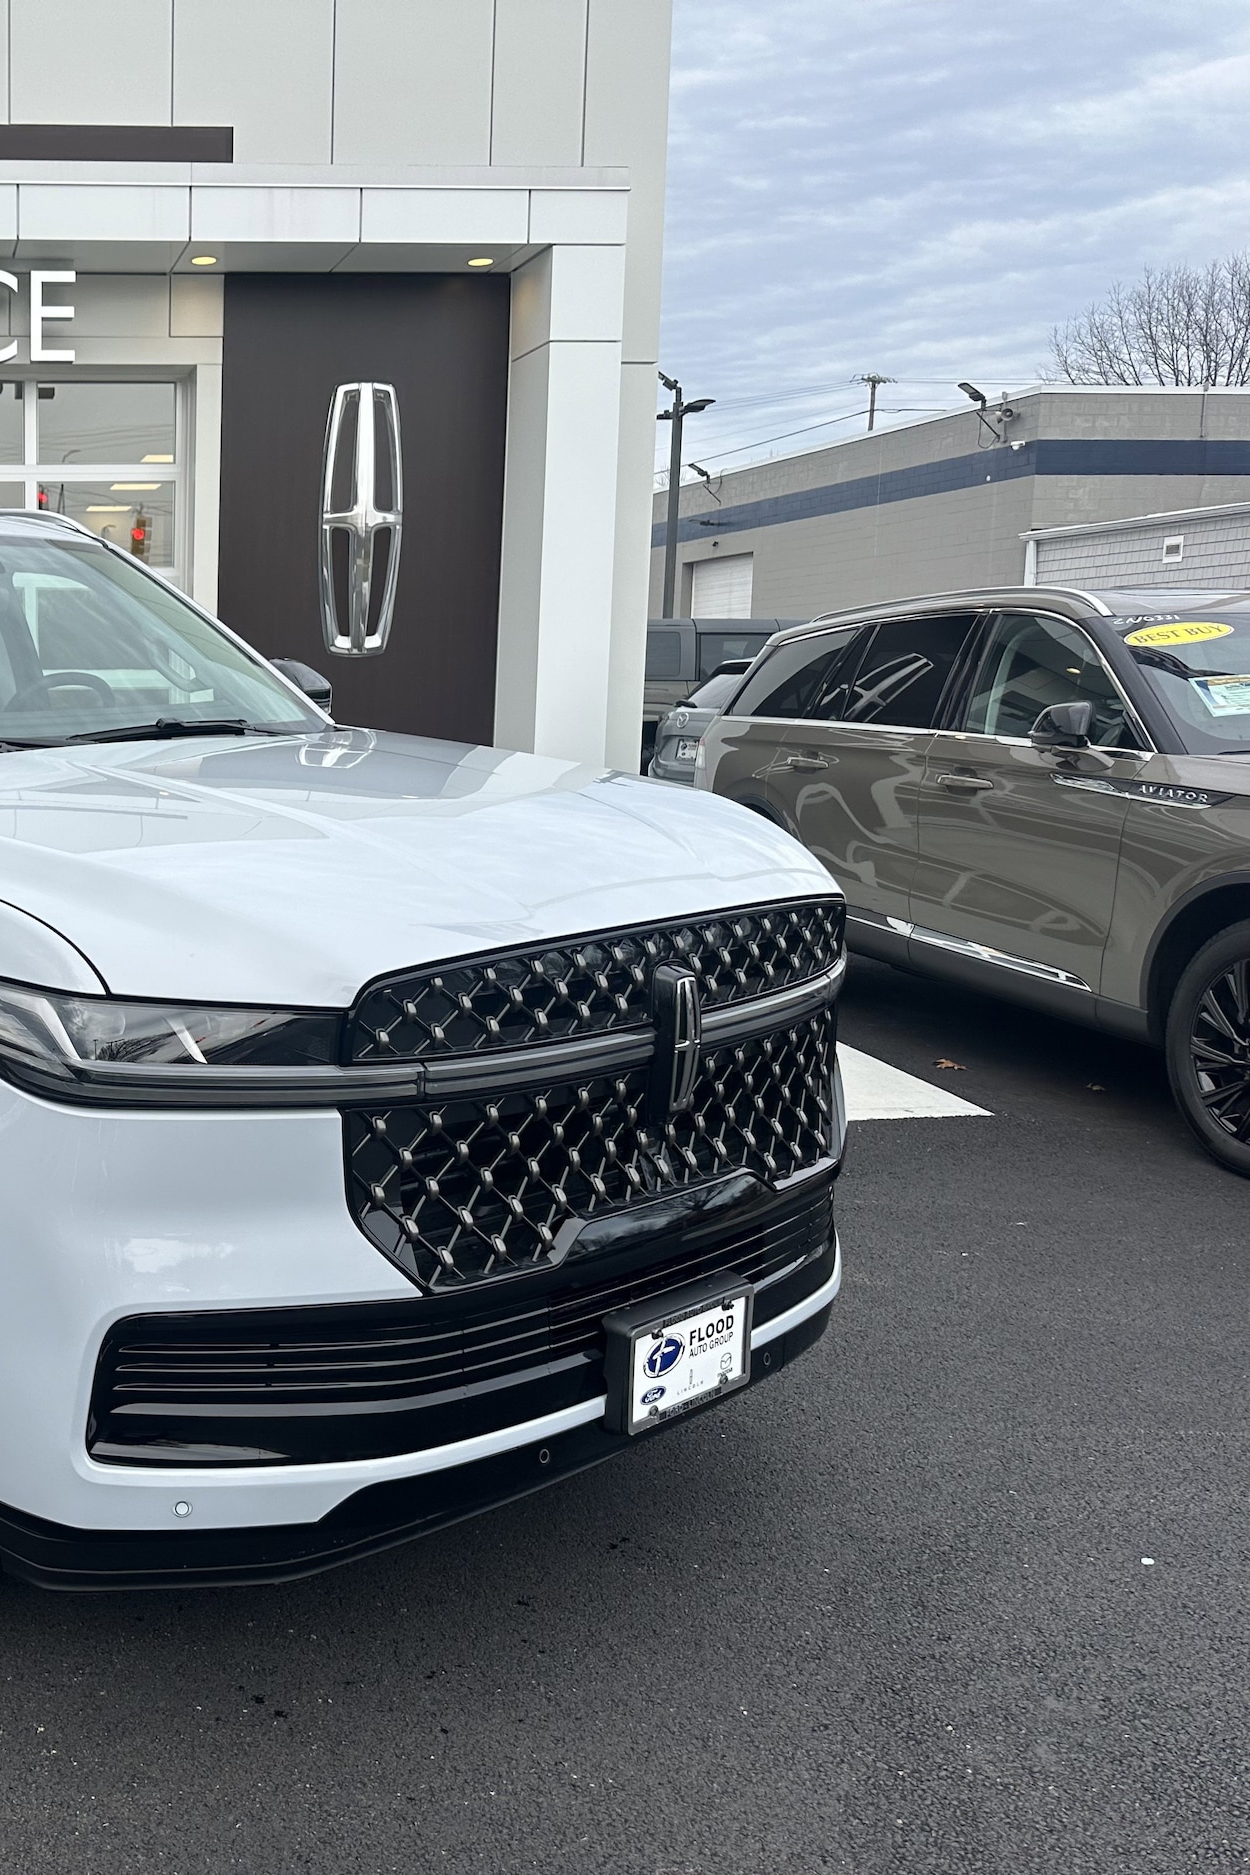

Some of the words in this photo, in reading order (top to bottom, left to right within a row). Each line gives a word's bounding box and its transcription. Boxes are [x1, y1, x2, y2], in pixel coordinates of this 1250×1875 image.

[1133, 629, 1182, 644] BEST
[1184, 624, 1224, 636] BUY
[1139, 784, 1208, 803] AVIATOR
[689, 1315, 734, 1346] FLOOD
[689, 1342, 708, 1358] AUTO
[709, 1331, 734, 1350] GROUP
